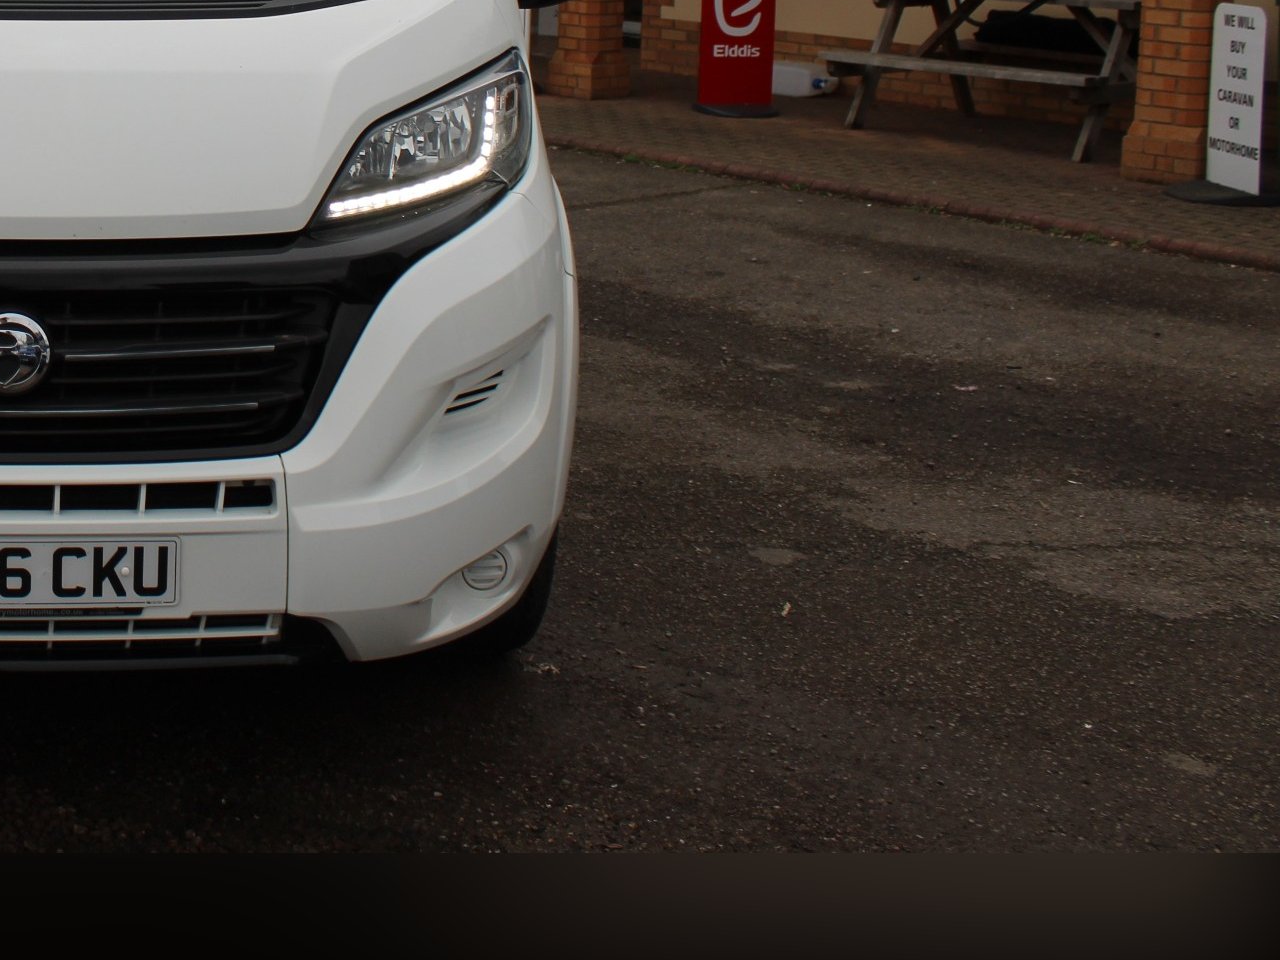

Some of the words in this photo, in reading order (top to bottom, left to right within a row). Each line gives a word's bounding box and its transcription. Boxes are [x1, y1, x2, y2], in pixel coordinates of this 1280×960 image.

[1224, 14, 1235, 27] WE
[1237, 15, 1255, 30] WILL
[713, 44, 761, 57] Elddis
[1230, 40, 1246, 54] BUY
[1226, 65, 1247, 80] YOUR
[1218, 88, 1254, 107] CARAVAN
[1229, 117, 1240, 130] OR
[1209, 137, 1258, 160] MOTORHOME
[52, 546, 169, 598] CKU
